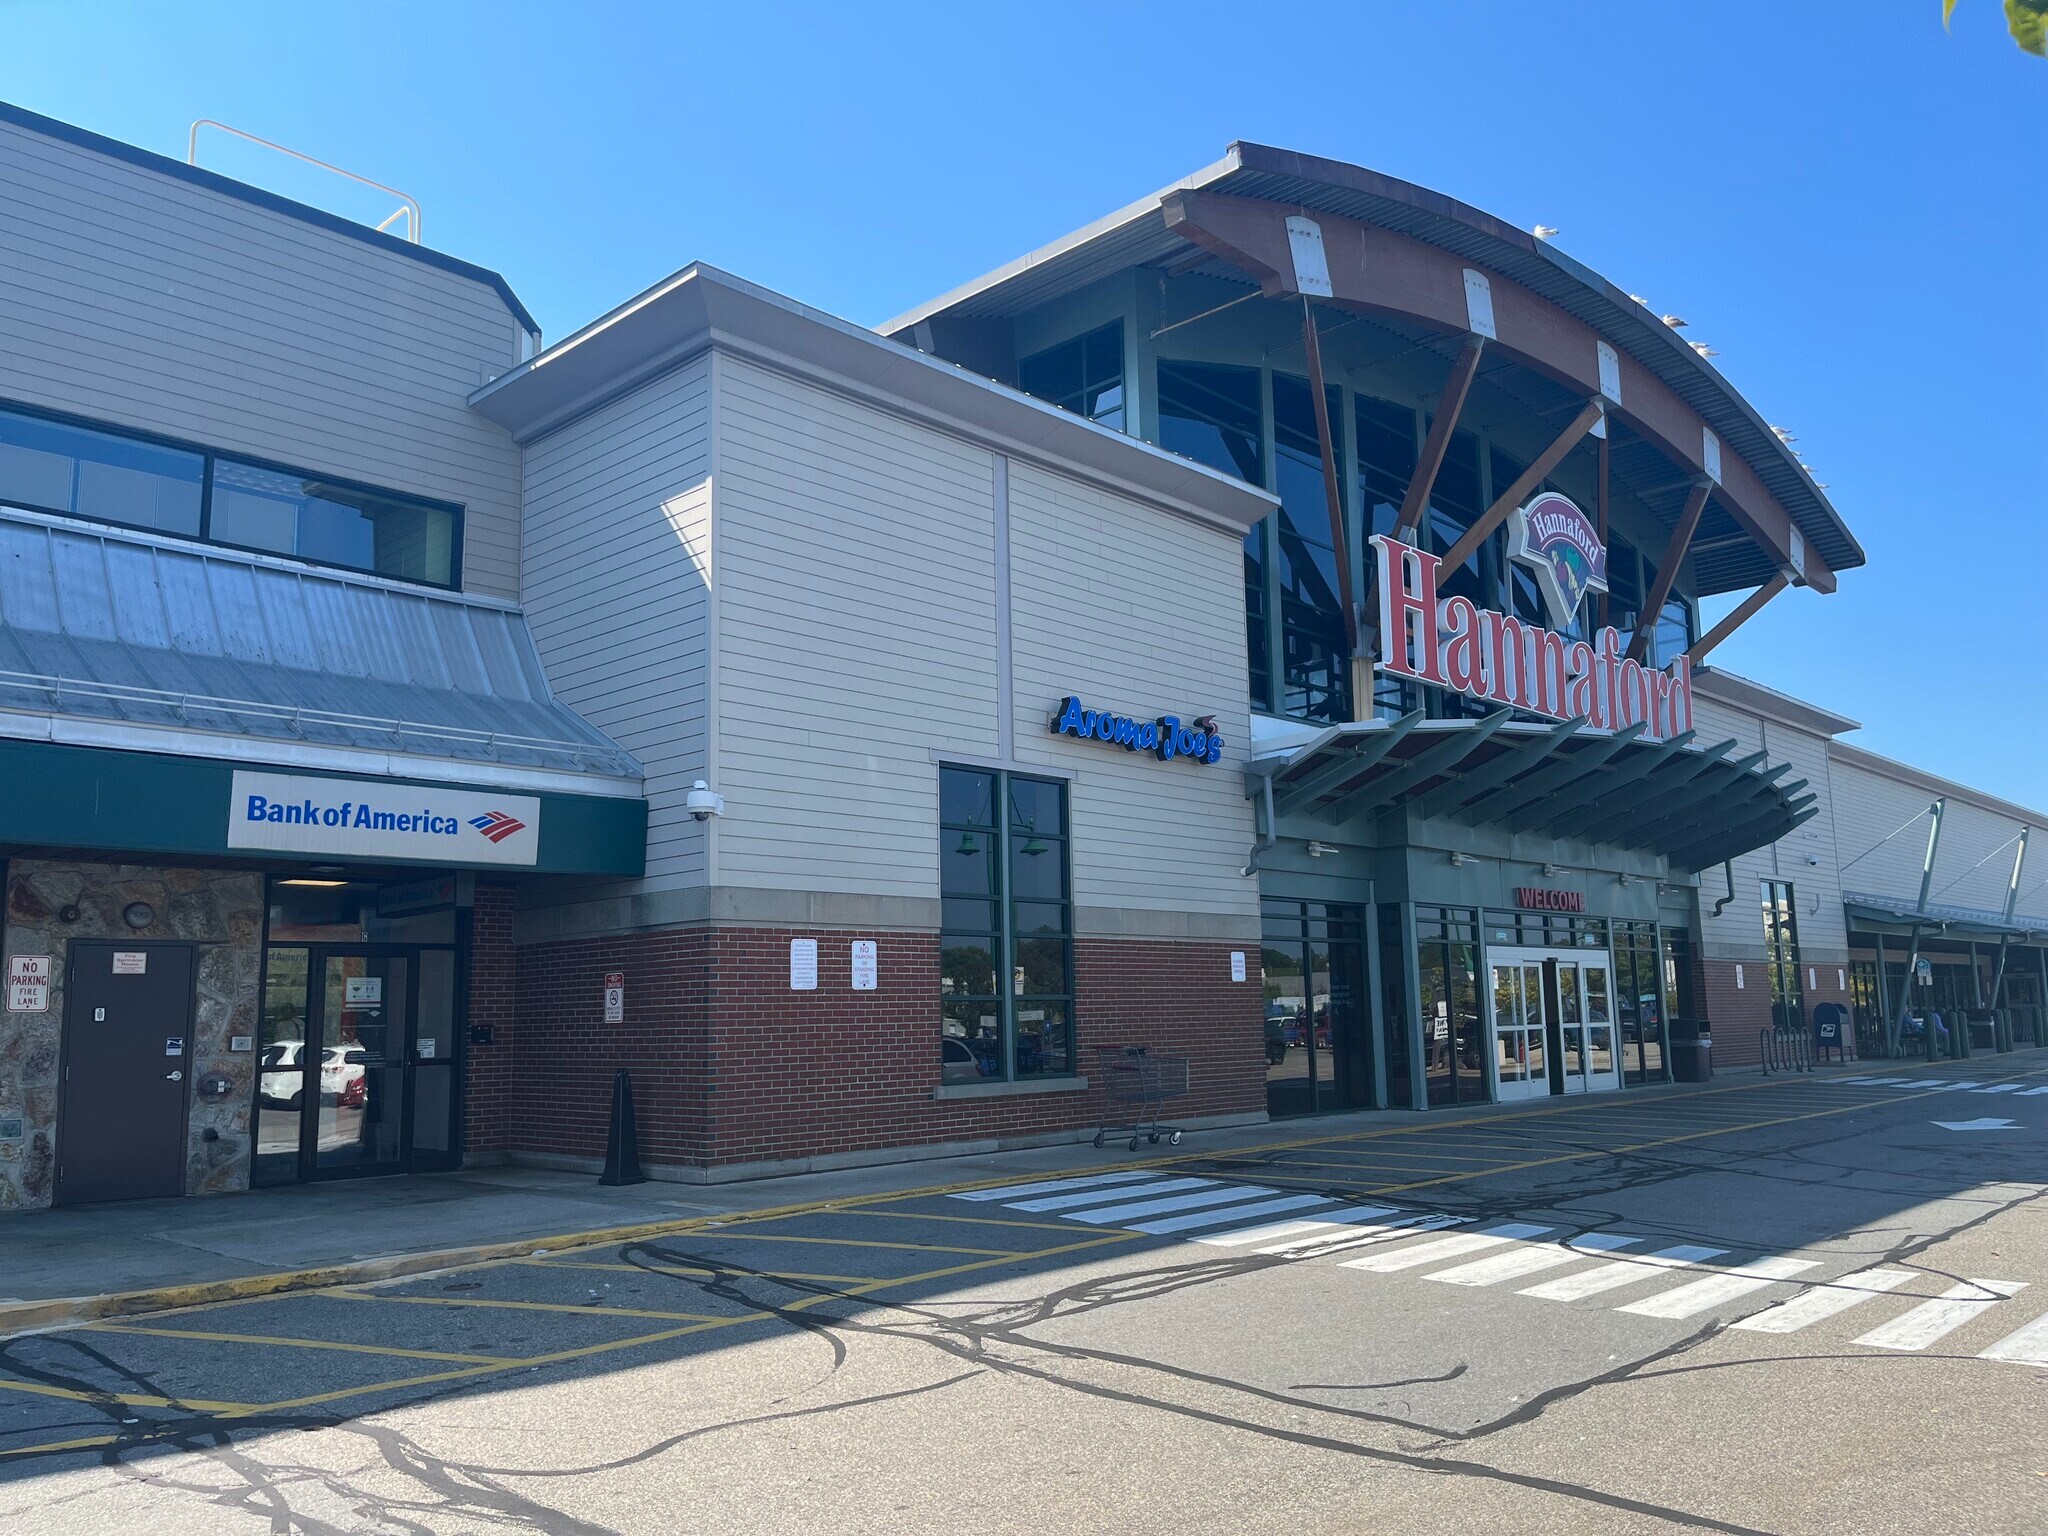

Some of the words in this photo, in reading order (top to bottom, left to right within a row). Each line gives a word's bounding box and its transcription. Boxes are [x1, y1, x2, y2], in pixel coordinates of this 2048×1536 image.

[1533, 511, 1599, 566] Hannaford
[1369, 534, 1694, 743] Hannaford
[1058, 695, 1159, 751] Aroma
[247, 795, 320, 825] Bank
[323, 802, 352, 827] of
[353, 804, 458, 835] America
[22, 962, 38, 973] NO
[11, 975, 47, 986] PARKING
[19, 988, 38, 996] FIRE
[17, 997, 38, 1006] LANE
